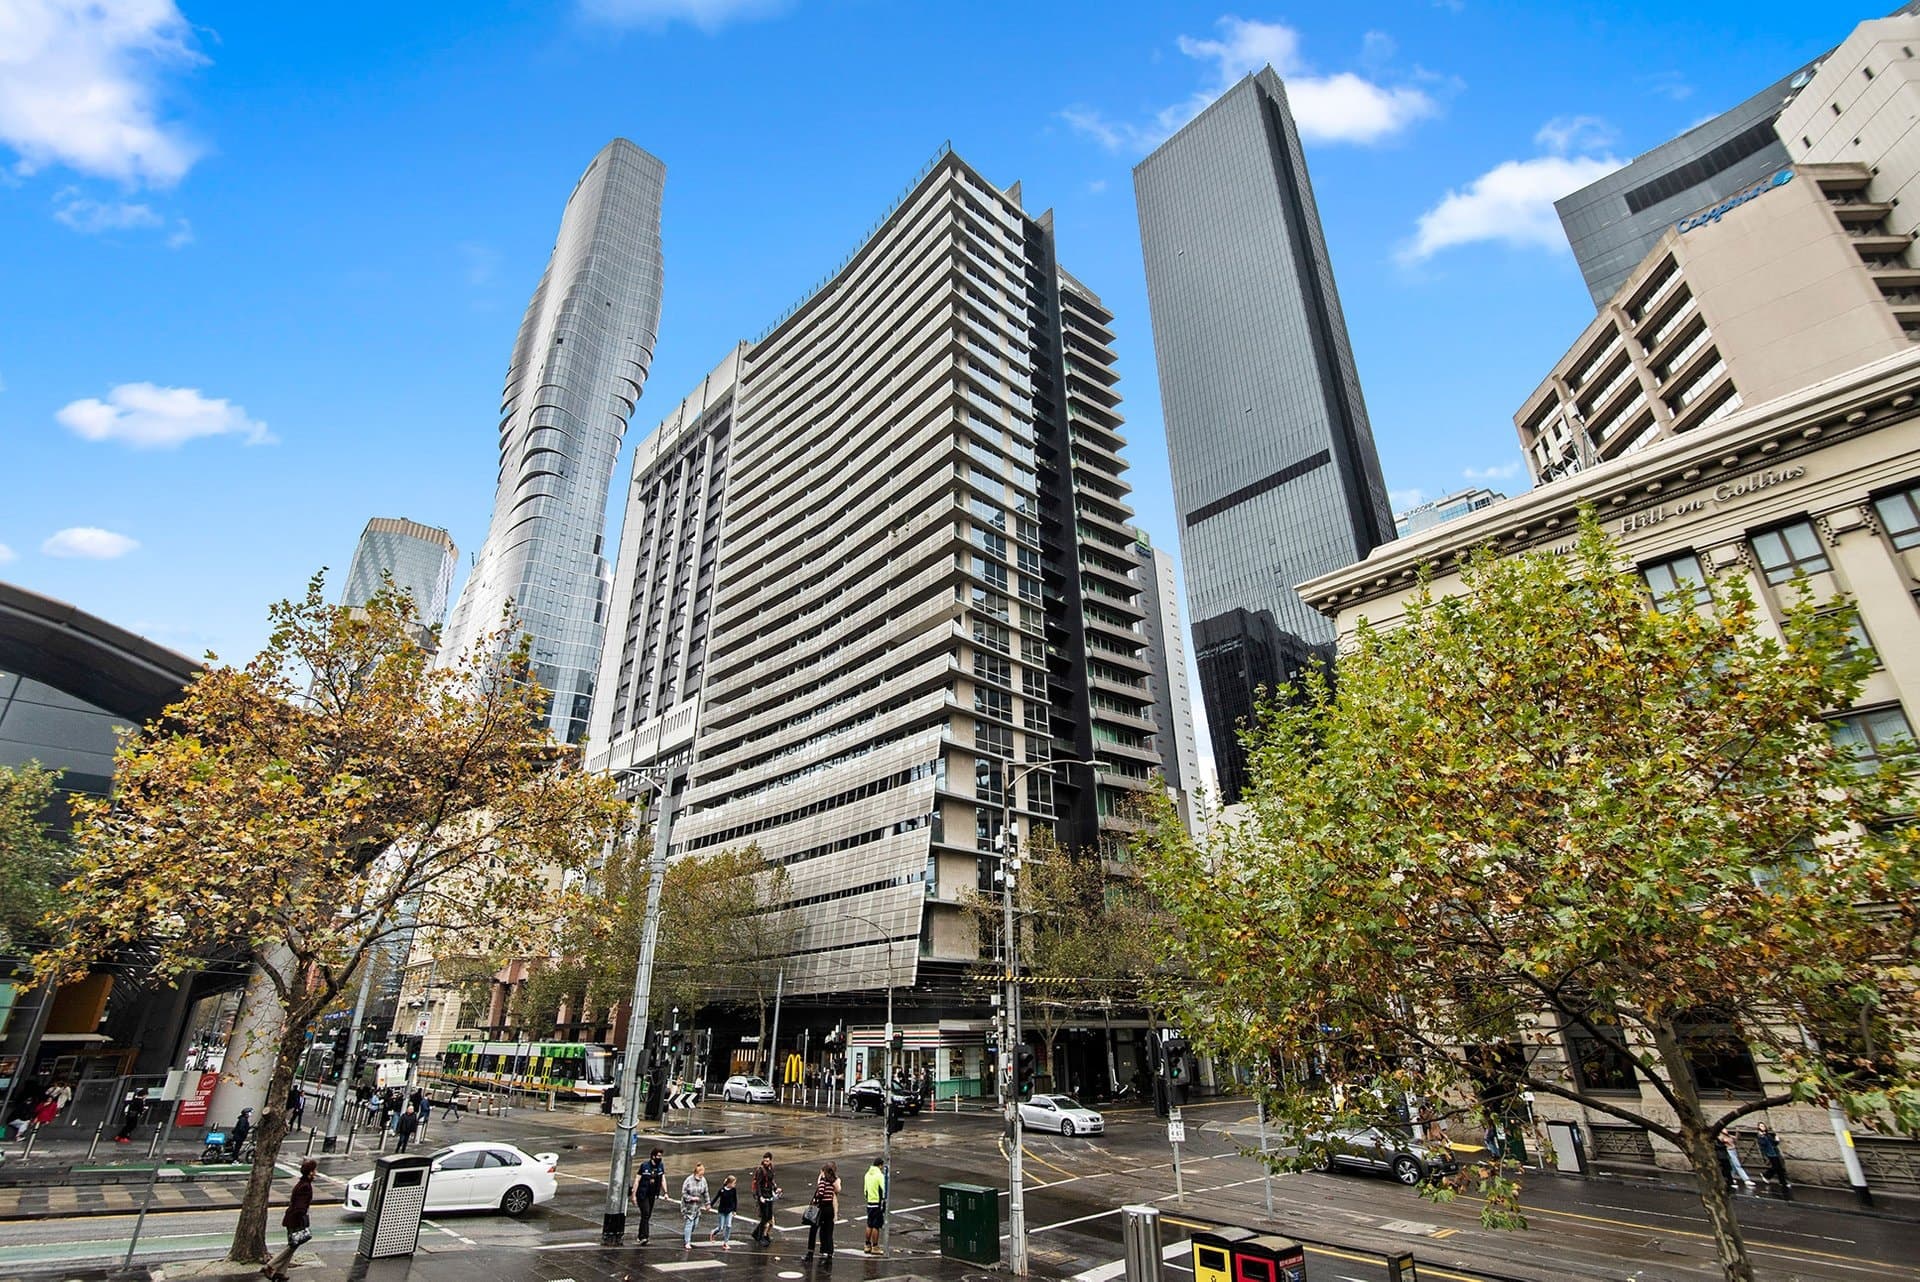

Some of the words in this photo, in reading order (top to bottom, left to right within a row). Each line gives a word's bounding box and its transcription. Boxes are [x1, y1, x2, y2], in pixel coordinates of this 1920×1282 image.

[1676, 179, 1769, 234] Capgemini
[1619, 507, 1665, 535] Hill
[1675, 497, 1704, 516] on
[1713, 465, 1805, 503] Collins
